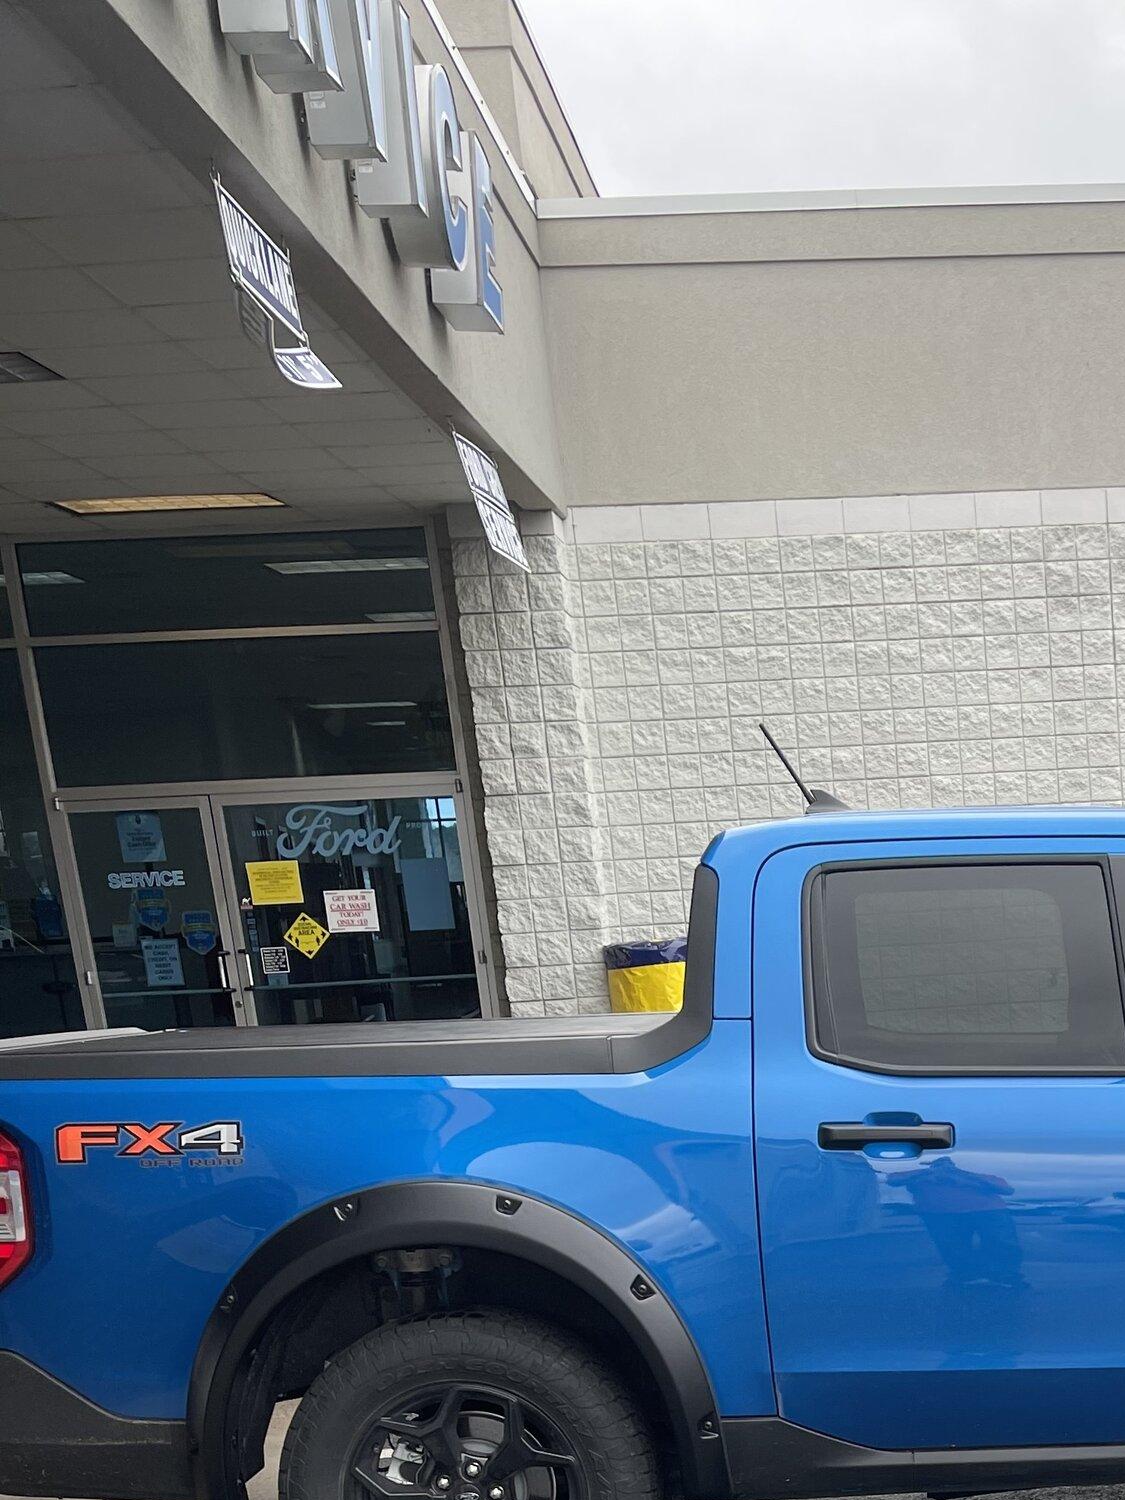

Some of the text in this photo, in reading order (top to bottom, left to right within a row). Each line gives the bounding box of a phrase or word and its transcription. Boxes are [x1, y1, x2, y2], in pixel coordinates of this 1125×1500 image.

[277, 805, 402, 858] Ford
[108, 870, 186, 890] SERVICE
[330, 902, 371, 911] CAR WASH
[55, 1120, 245, 1165] FX4
[139, 1157, 244, 1168] OFF ROAD
